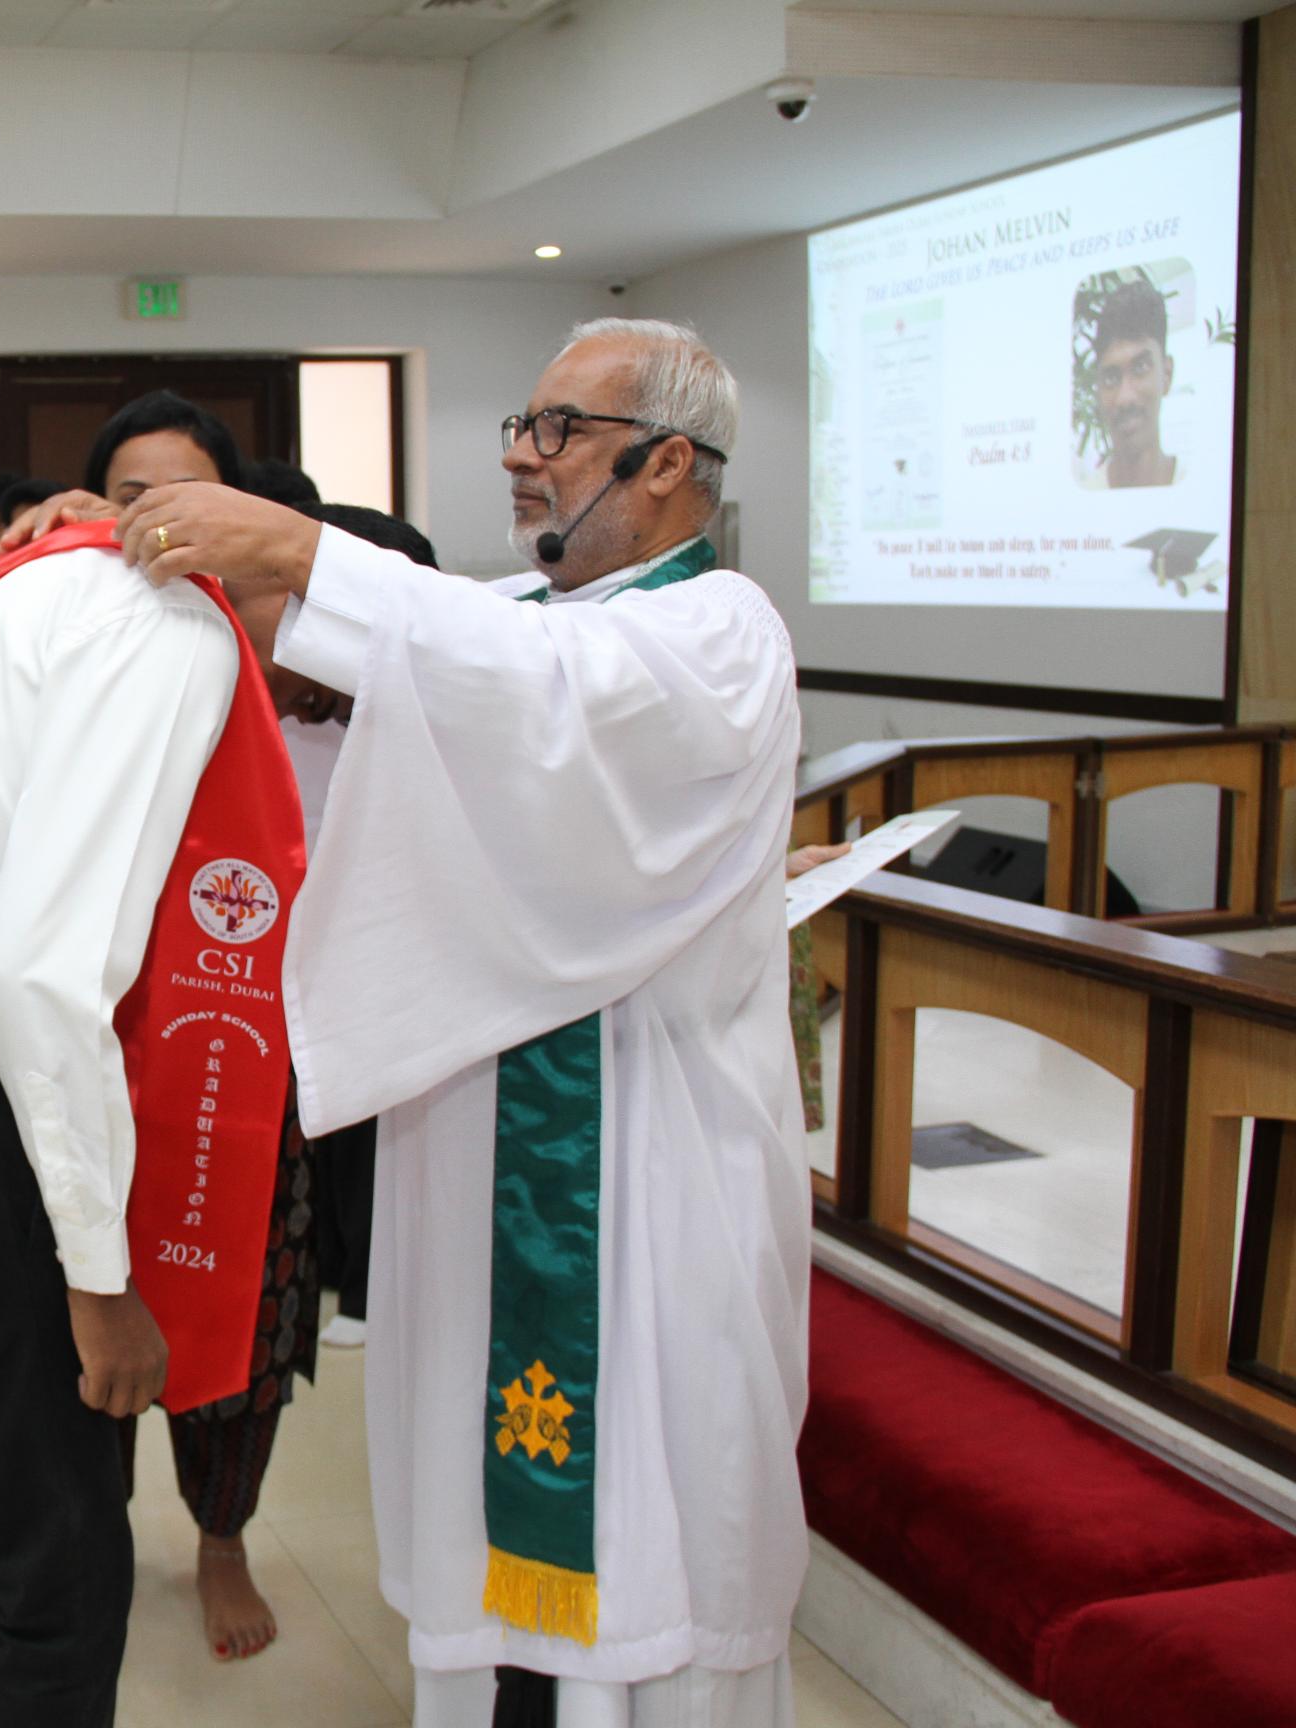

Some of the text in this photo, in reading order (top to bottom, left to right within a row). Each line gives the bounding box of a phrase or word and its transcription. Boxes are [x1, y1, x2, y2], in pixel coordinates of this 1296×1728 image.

[927, 228, 988, 267] JOHAN
[995, 205, 1071, 247] MELVIN
[1030, 243, 1066, 268] AND
[1116, 226, 1137, 247] US
[1139, 215, 1181, 244] SAFE
[197, 948, 255, 979] CSI
[230, 982, 275, 1002] DUBAI
[161, 1010, 270, 1057] SUNDAY SCHOOL
[182, 1038, 225, 1227] GRADUATION
[157, 1239, 217, 1272] 2024
